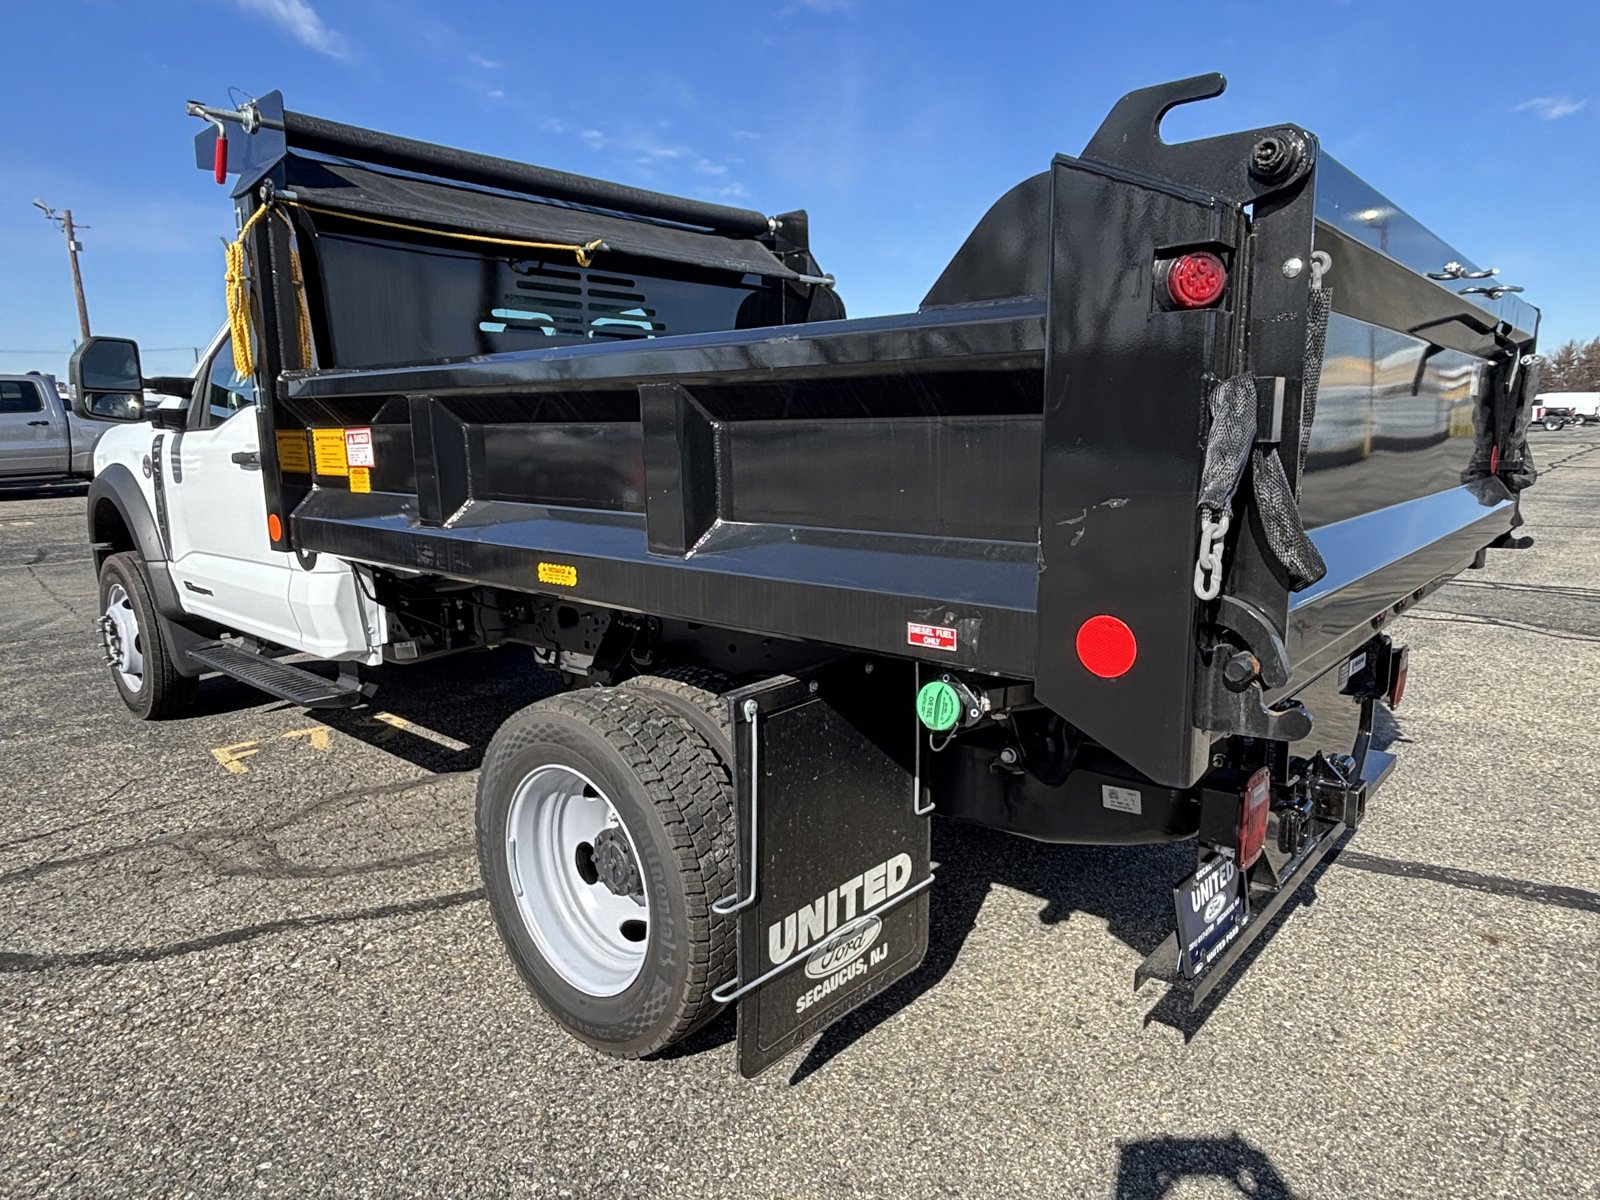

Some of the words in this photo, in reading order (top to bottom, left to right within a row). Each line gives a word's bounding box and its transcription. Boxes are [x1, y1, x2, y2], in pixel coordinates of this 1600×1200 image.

[910, 626, 934, 636] DIESEL
[935, 629, 953, 639] FUEL
[923, 636, 940, 646] ONLY
[926, 696, 935, 718] DIESEL
[1191, 861, 1234, 912] UNITED
[768, 853, 913, 965] UNITED
[821, 925, 866, 970] Ford
[1206, 939, 1226, 963] UNITED
[796, 957, 868, 1014] SECAUCUS,
[870, 942, 889, 967] NJ
